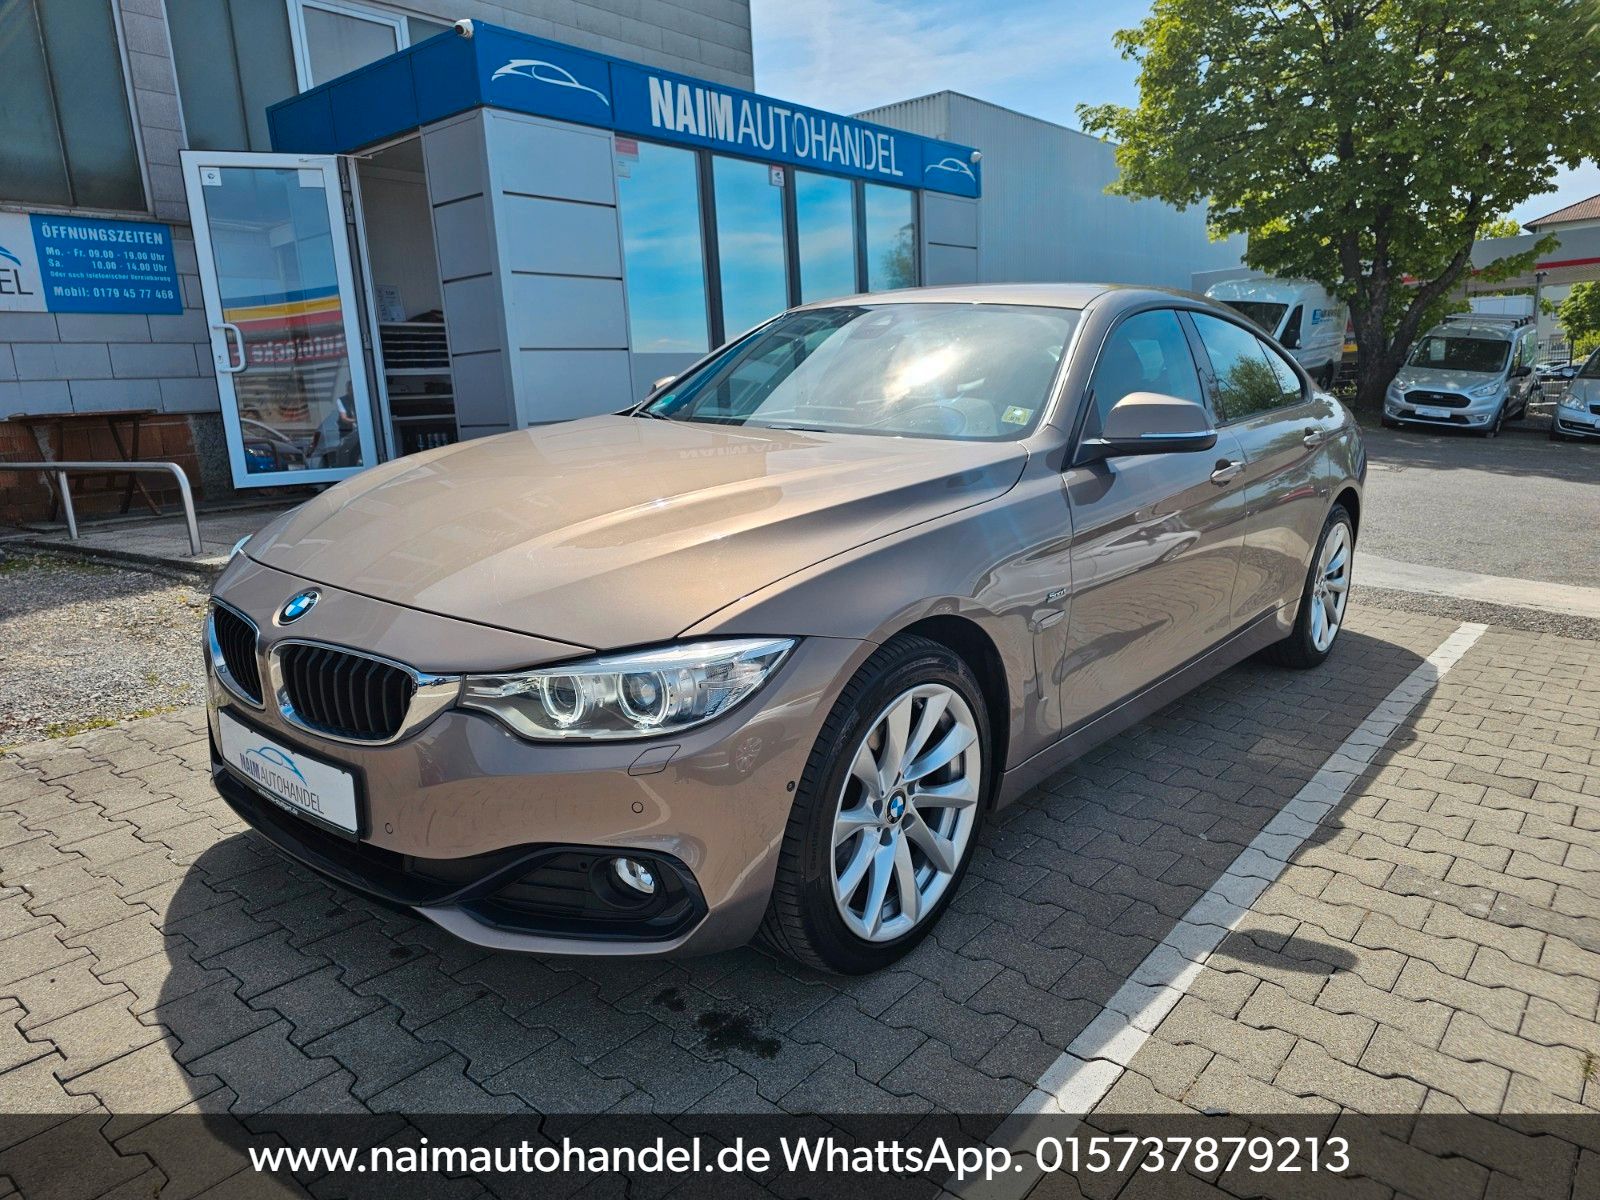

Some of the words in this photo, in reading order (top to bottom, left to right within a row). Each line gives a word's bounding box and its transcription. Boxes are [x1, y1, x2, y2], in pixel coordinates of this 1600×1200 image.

[41, 222, 164, 245] ÖFFNUNGSZEITEN
[45, 246, 64, 257] Mo.
[73, 248, 86, 258] Fr.
[88, 249, 114, 259] 09.00
[123, 251, 148, 261] 19.00
[150, 252, 166, 262] Uhr
[48, 258, 64, 268] Sa.
[92, 260, 117, 270] 10.00
[127, 262, 151, 271] 14.00
[152, 263, 168, 272] Uhr
[53, 286, 90, 297] Mobil:
[93, 287, 120, 298] 0179
[123, 288, 136, 299] 45
[140, 288, 152, 299] 77
[155, 289, 174, 300] 468
